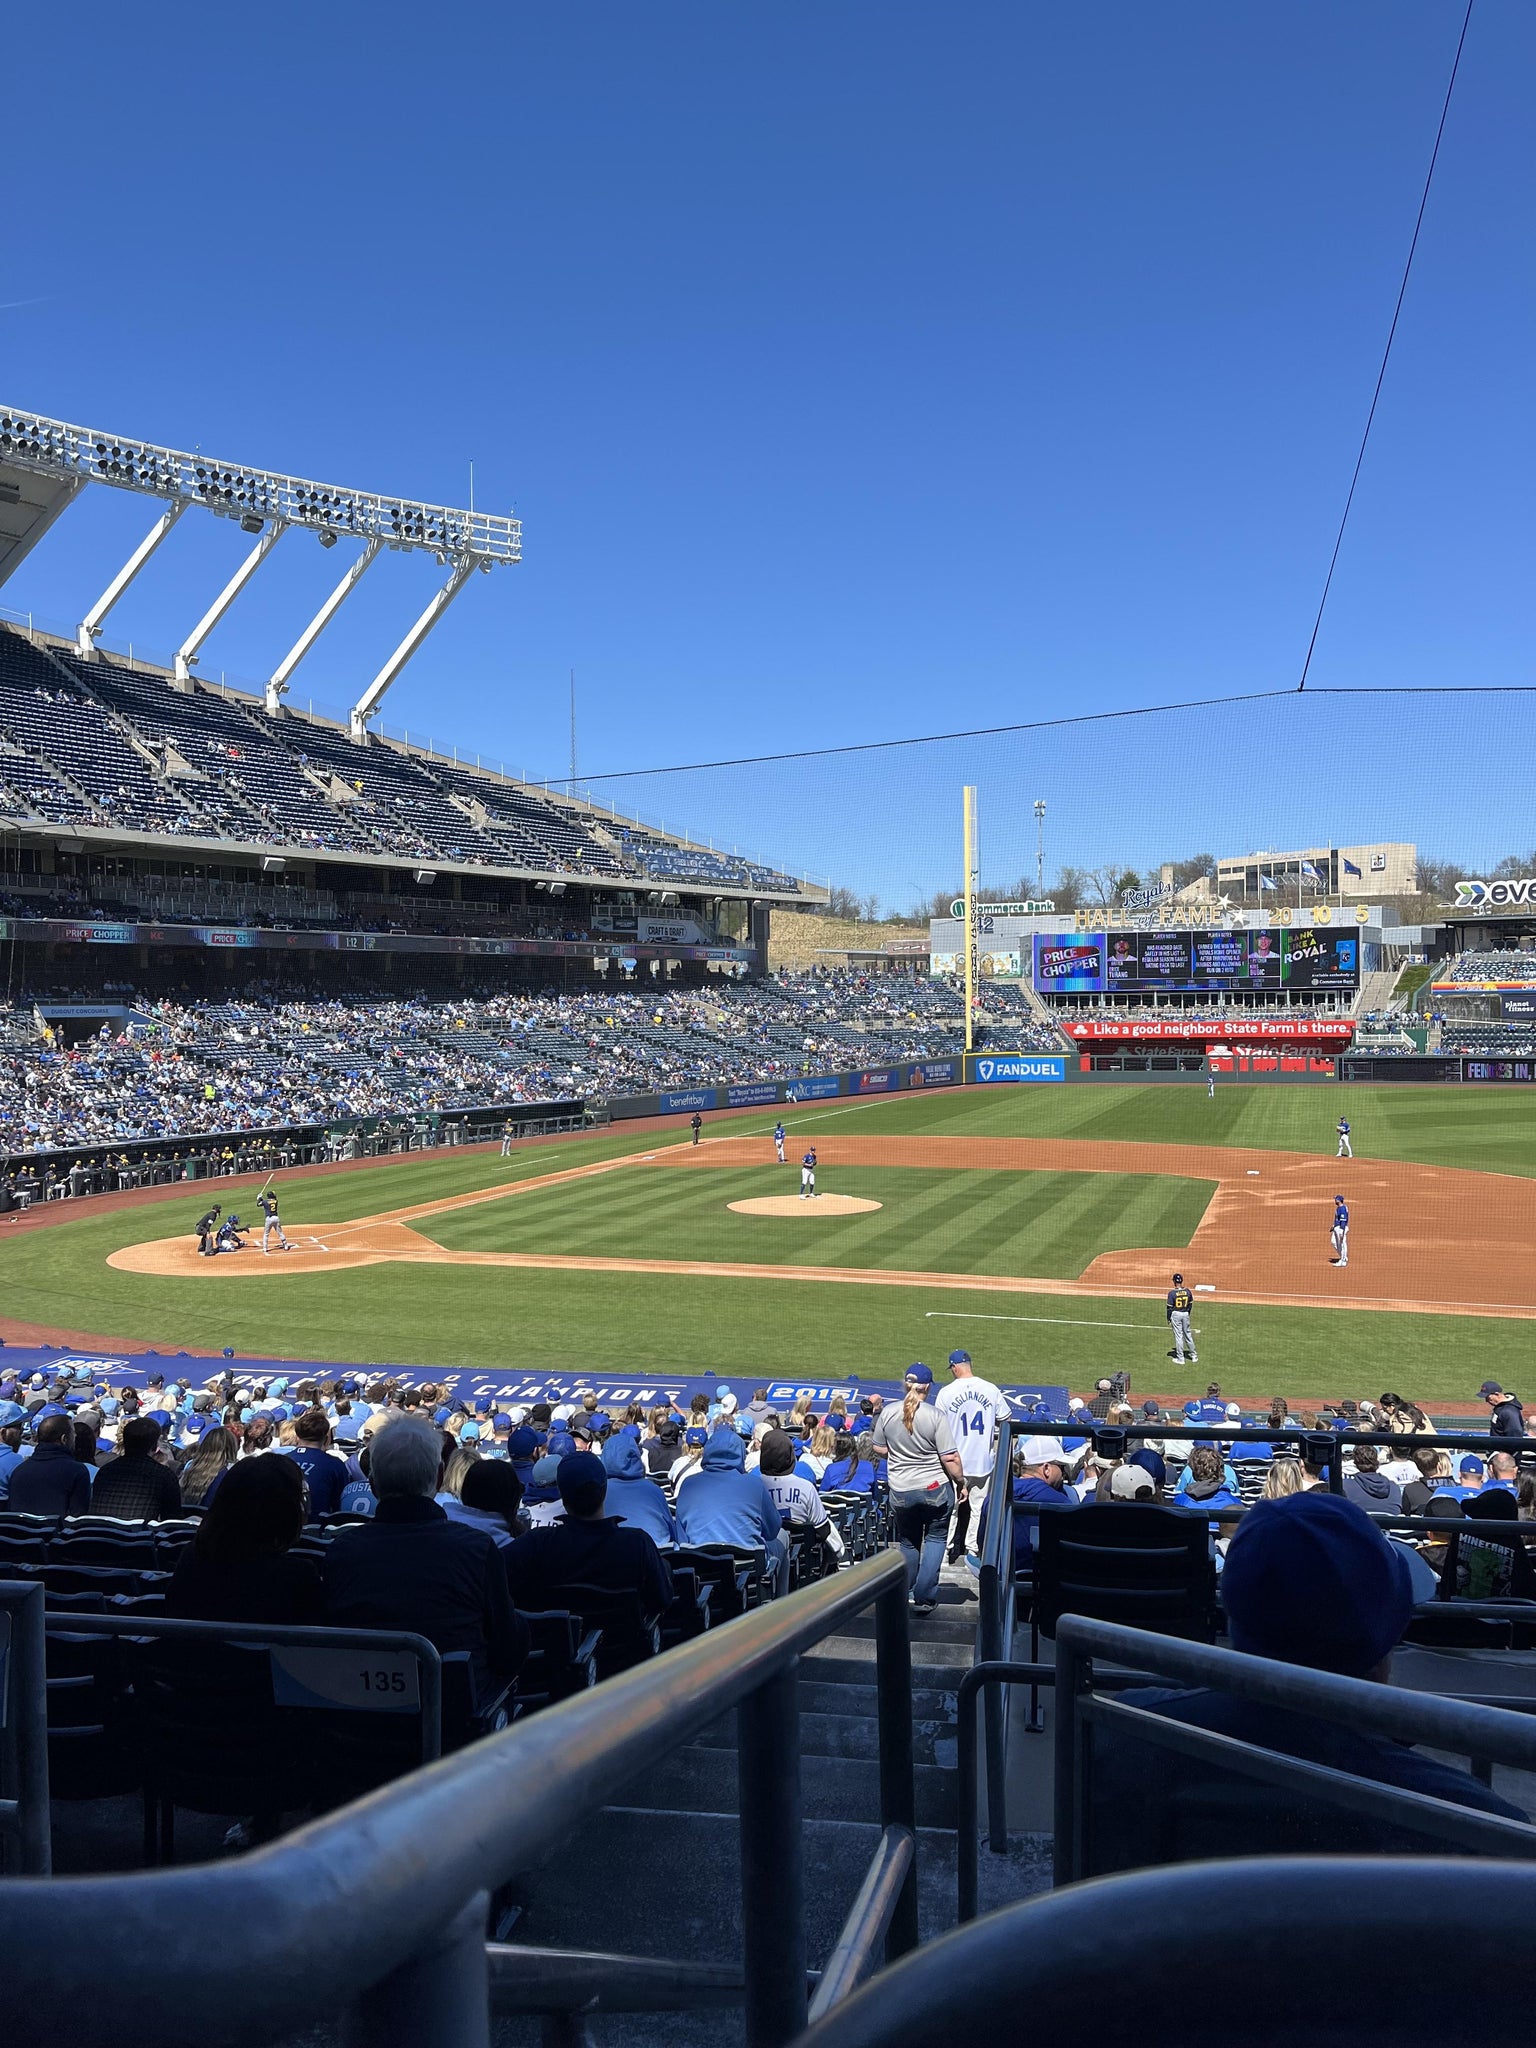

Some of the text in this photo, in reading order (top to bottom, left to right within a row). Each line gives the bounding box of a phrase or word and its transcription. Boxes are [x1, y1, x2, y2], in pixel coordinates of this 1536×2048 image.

[1122, 880, 1173, 909] Royals
[977, 900, 1054, 913] ommerce Bank
[1074, 909, 1134, 927] HALL
[1159, 905, 1224, 924] FAME
[1268, 905, 1369, 924] 20 10 5
[65, 929, 130, 939] PRICE CHOPPER
[649, 926, 664, 936] CRAFT
[670, 927, 685, 936] DRAFT
[1287, 930, 1314, 943] BANK
[214, 935, 234, 943] PRICE
[1288, 940, 1308, 951] LIKE
[1043, 948, 1078, 963] PRICE
[1284, 943, 1327, 963] ROYAL
[1042, 957, 1098, 978] CHOPPER
[1094, 1024, 1118, 1034] Like
[1132, 1024, 1161, 1036] good
[1164, 1023, 1221, 1036] neighbor,
[1224, 1023, 1258, 1033] State
[1261, 1023, 1294, 1033] Farm
[1298, 1022, 1308, 1033] is
[1311, 1022, 1350, 1033] there.
[1134, 1046, 1200, 1056] State Farm
[1281, 1043, 1323, 1059] Farm
[997, 1063, 1060, 1076] FANDUEL
[1515, 1063, 1532, 1080] IN,
[669, 1094, 706, 1107] benefitbay
[270, 1203, 276, 1212] 2
[1175, 1296, 1189, 1308] 67
[313, 1369, 591, 1387] HOME OF THE
[473, 1384, 681, 1402] CHAMPIONS
[772, 1386, 852, 1401] 2015
[949, 1391, 993, 1414] CAGLIANONE
[961, 1411, 985, 1436] 14
[1459, 1533, 1515, 1558] MINECRAFT
[359, 1670, 406, 1693] 135
